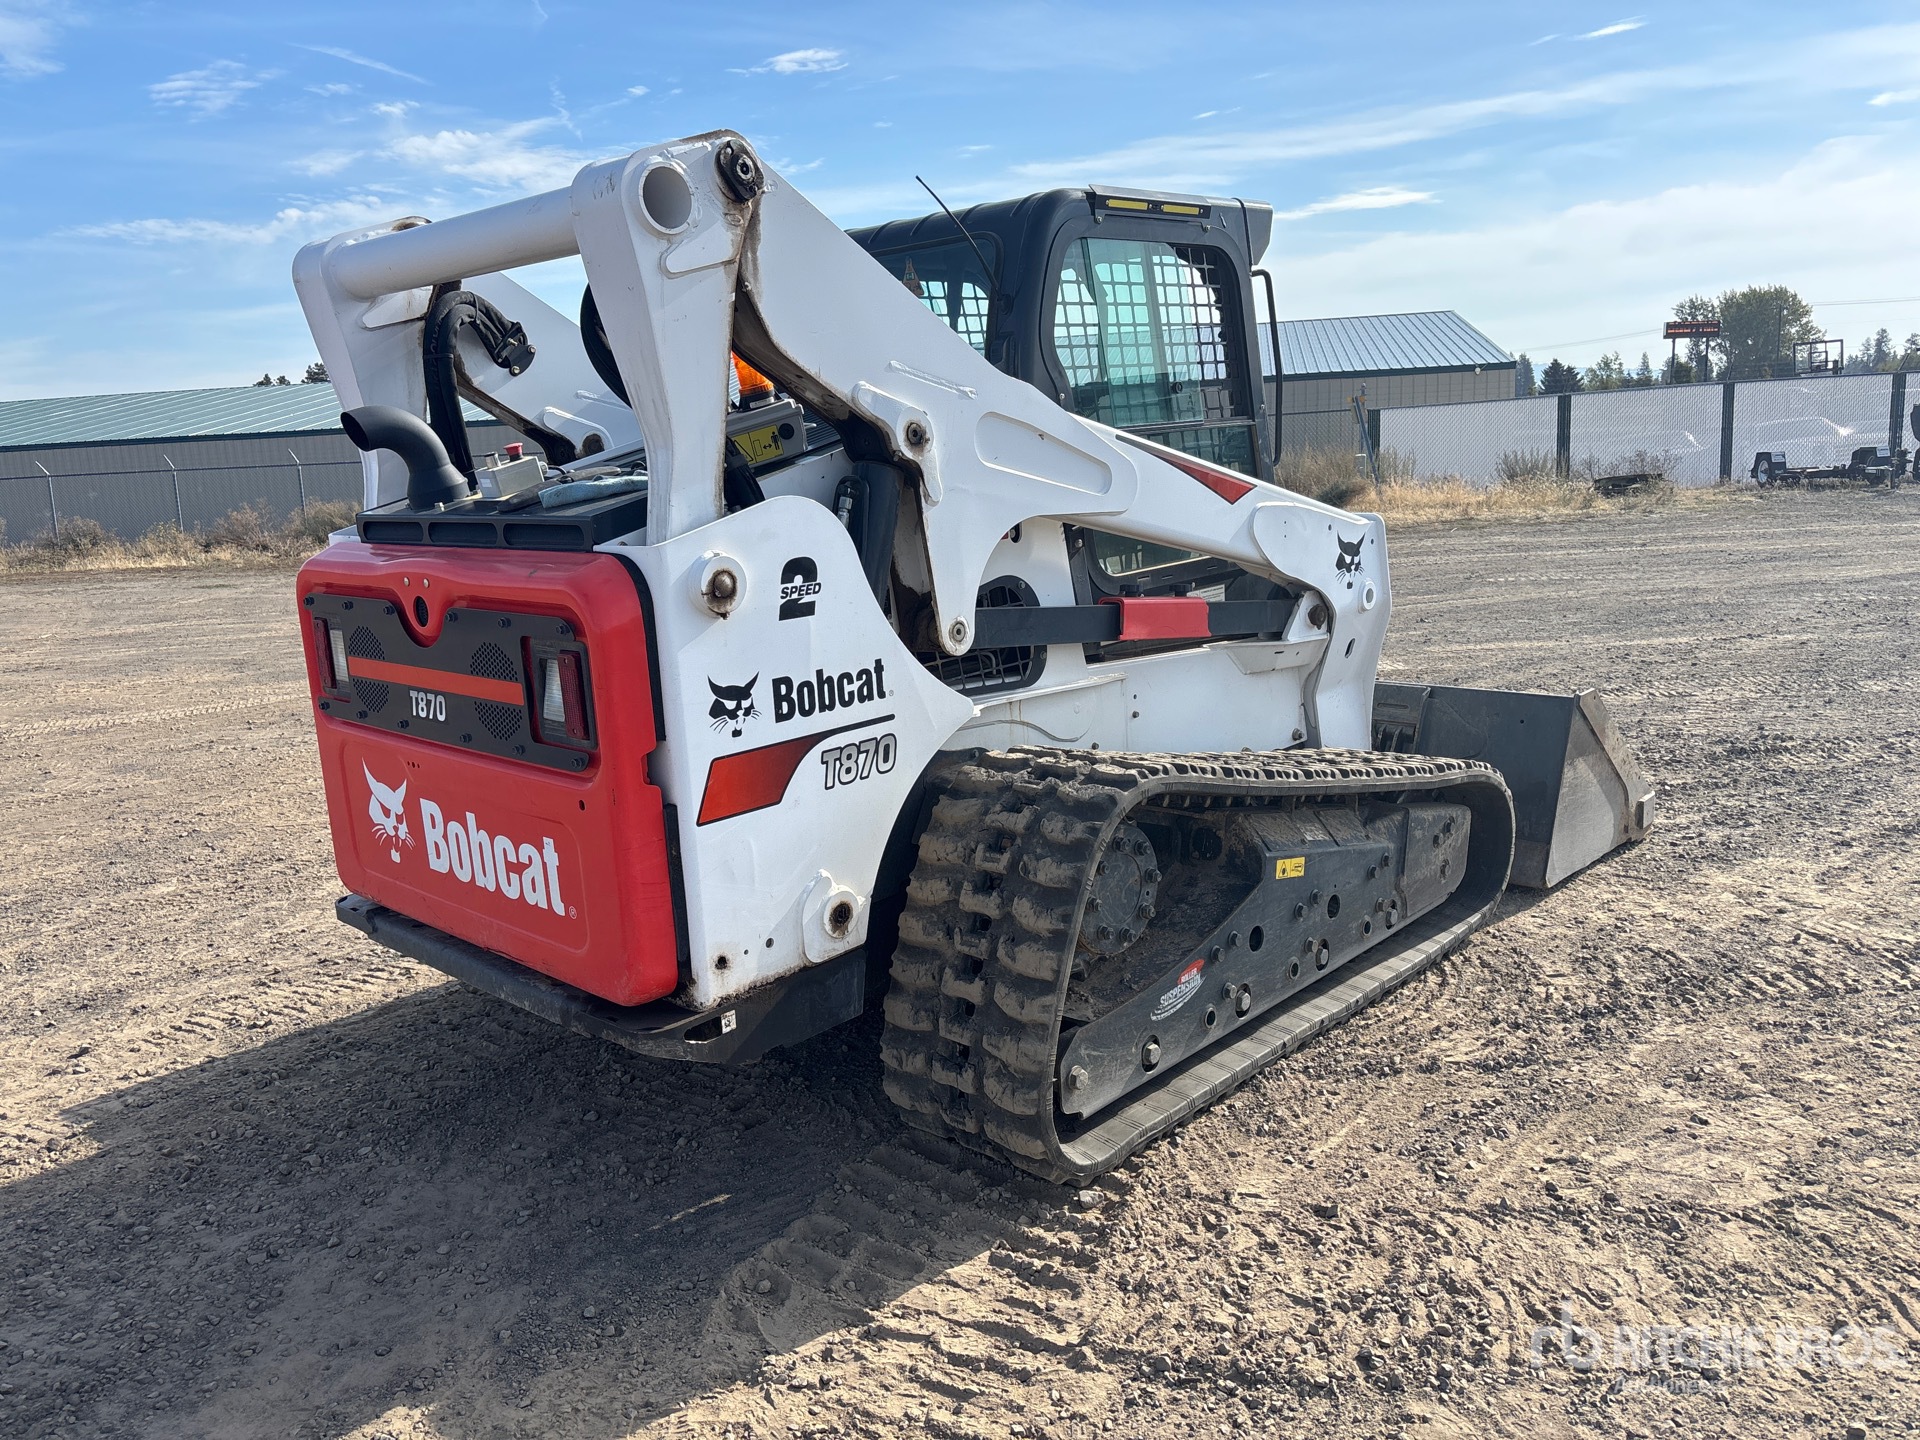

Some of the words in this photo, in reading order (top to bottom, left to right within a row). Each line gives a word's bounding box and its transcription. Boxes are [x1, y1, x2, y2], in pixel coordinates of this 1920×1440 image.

[779, 556, 818, 621] 2
[780, 582, 822, 600] SPEED
[409, 689, 446, 722] T870
[821, 733, 897, 791] T870
